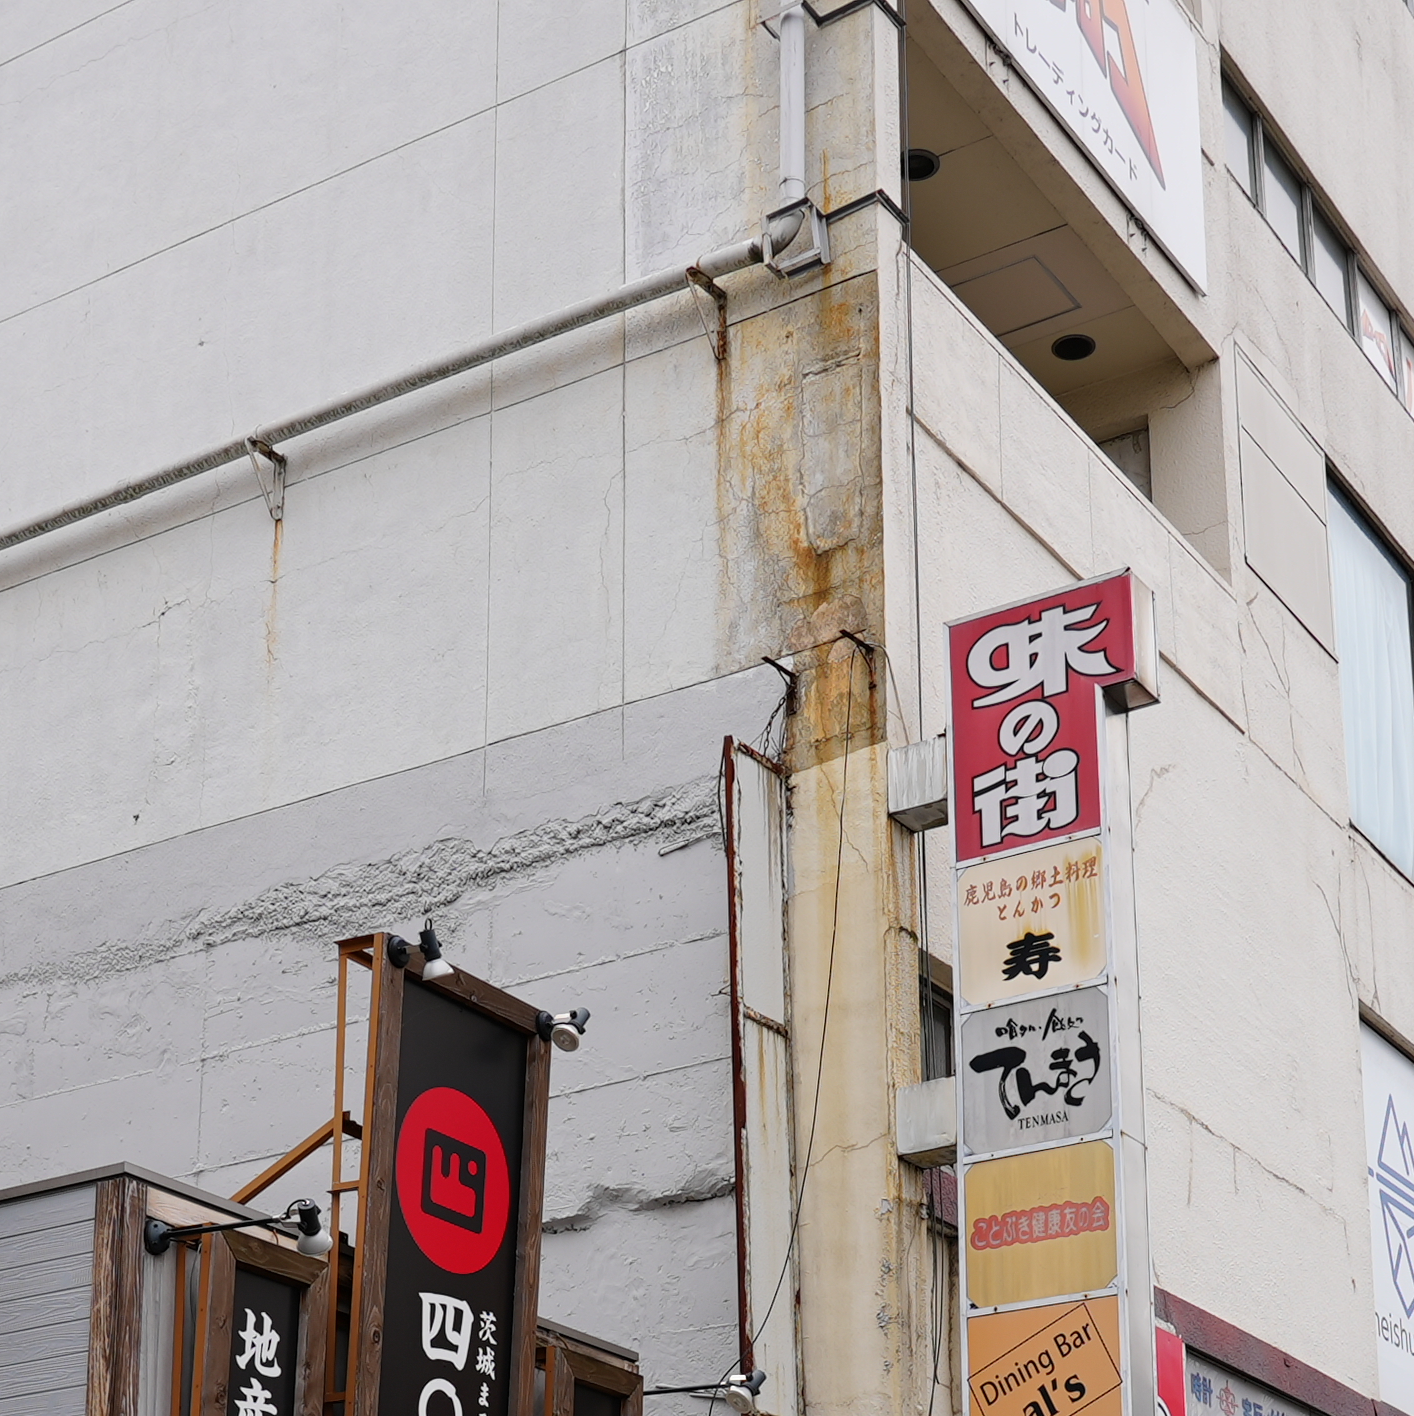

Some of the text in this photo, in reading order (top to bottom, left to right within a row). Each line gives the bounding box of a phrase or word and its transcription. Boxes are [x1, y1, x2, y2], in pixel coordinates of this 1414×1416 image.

[1011, 12, 1140, 182] トレーディングカード
[966, 600, 1123, 850] 味の街
[964, 856, 1098, 907] 鹿児島の郷土料理
[997, 892, 1062, 921] とんかつ
[1002, 931, 1063, 981] 寿
[1018, 1110, 1069, 1131] TENMASA
[972, 1199, 1108, 1249] ことぶき健康友の会
[979, 1320, 1092, 1406] Dining Bar
[1190, 1372, 1213, 1407] 時計
